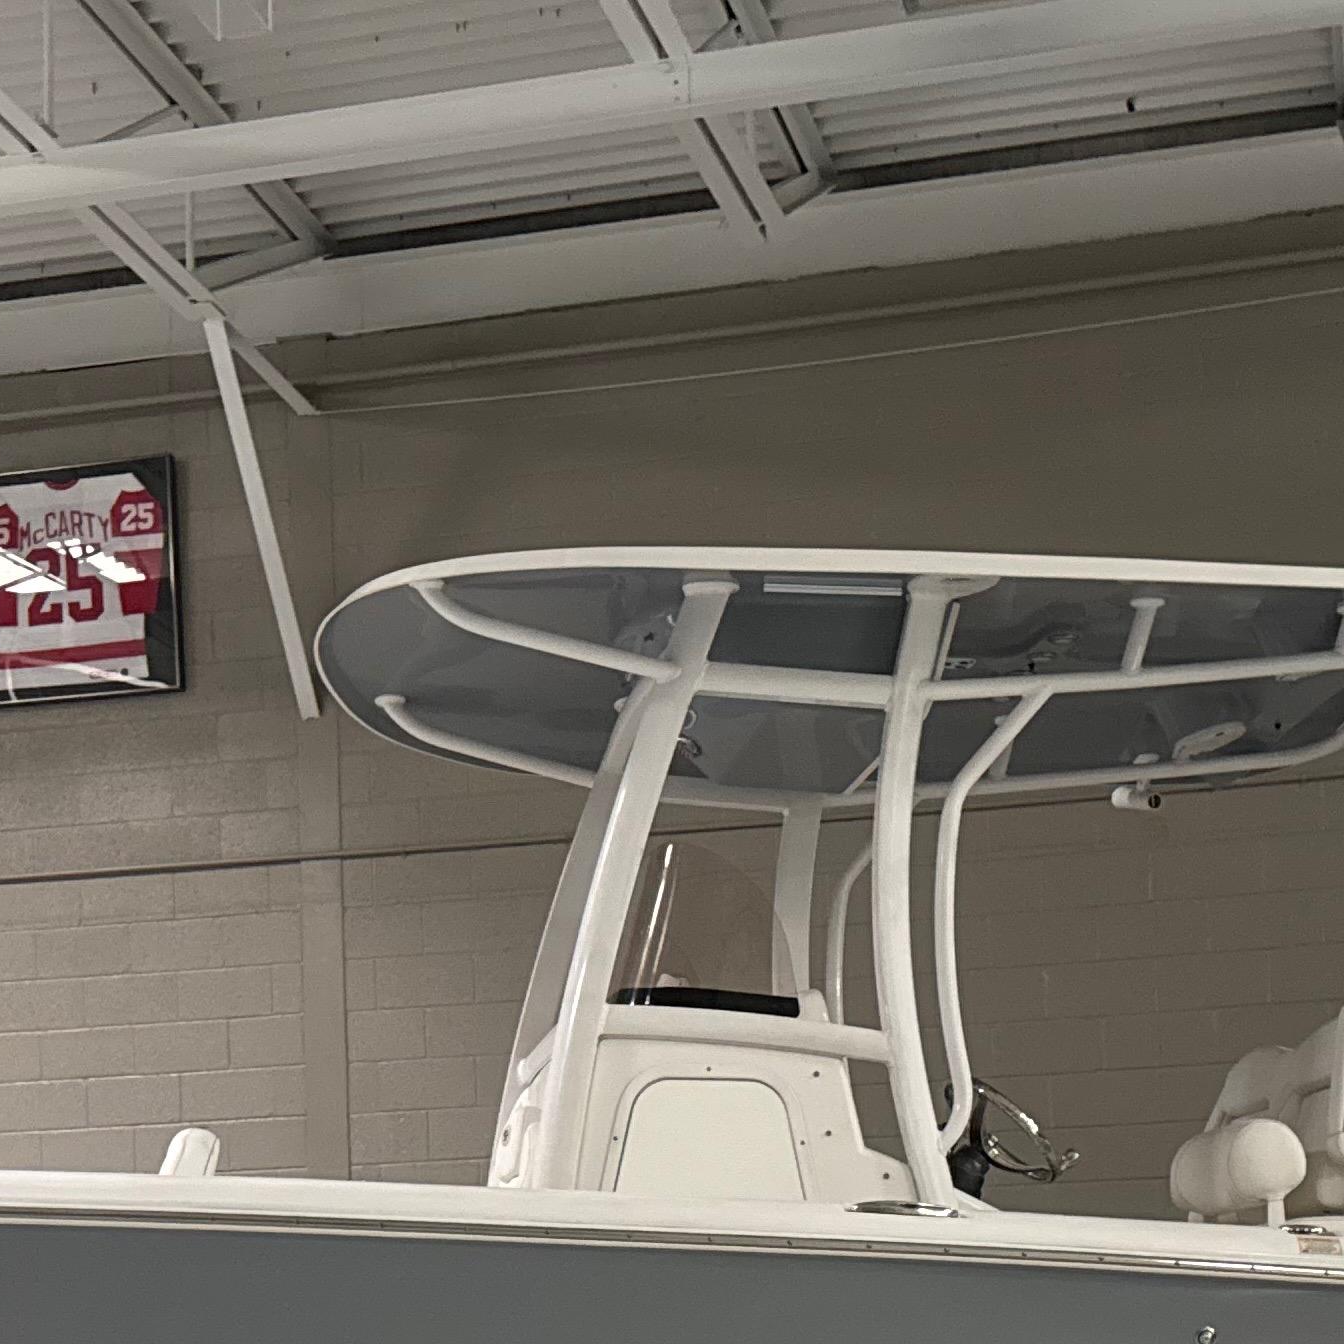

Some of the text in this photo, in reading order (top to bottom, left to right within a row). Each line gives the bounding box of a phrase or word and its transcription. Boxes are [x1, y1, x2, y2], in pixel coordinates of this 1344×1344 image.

[19, 510, 109, 553] McCARTY
[119, 502, 155, 533] 25
[24, 543, 105, 627] 25
